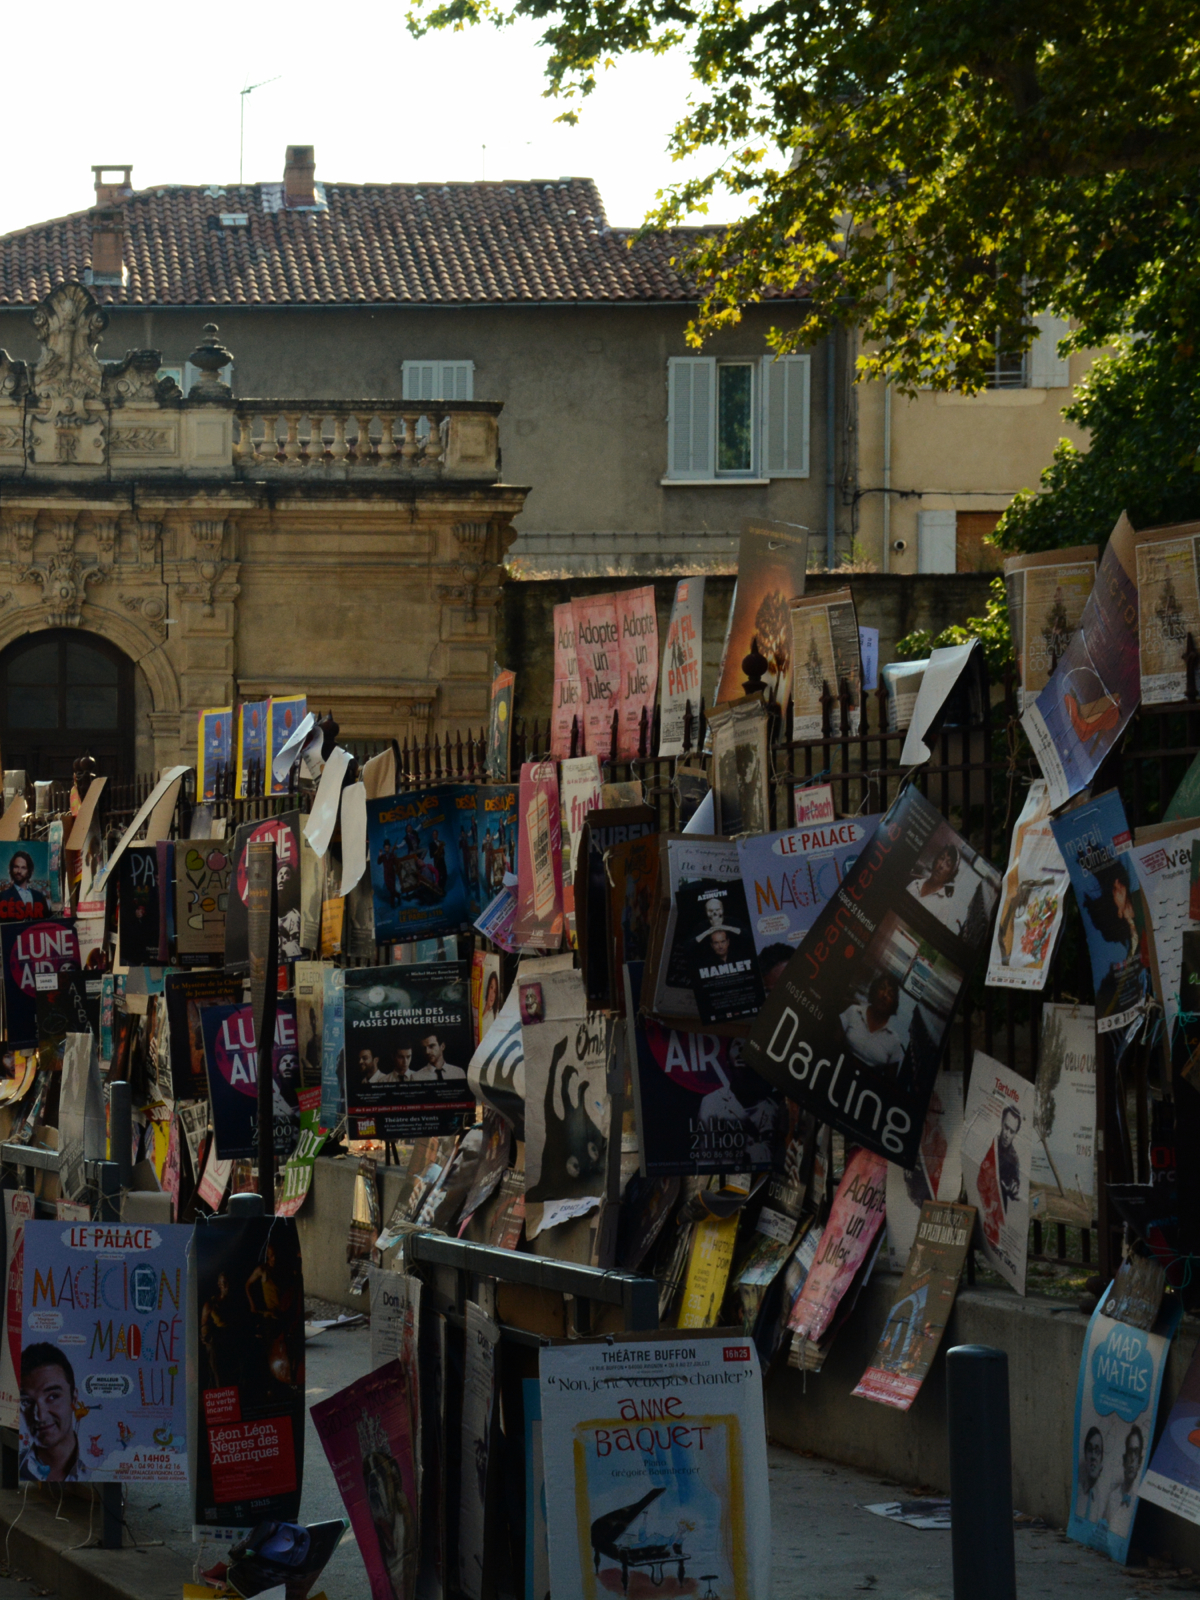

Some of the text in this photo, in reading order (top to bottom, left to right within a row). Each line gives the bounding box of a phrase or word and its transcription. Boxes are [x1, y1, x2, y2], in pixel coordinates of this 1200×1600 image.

[578, 619, 618, 649] Adopte
[623, 610, 654, 639] Adopte
[681, 614, 696, 643] FIL
[592, 651, 609, 671] un
[636, 644, 648, 665] un
[625, 671, 648, 699] Jules
[668, 659, 699, 696] PATTE
[586, 675, 613, 704] Jules
[378, 795, 440, 824] DÉSAXÉS
[780, 825, 857, 855] LE PALACE
[1065, 825, 1103, 857] magali
[697, 889, 728, 902] AZIMUTH
[837, 888, 877, 933] Espace St Martial
[16, 929, 74, 961] LUNE
[699, 959, 752, 979] HAMLET
[181, 981, 206, 991] Mystère
[185, 987, 234, 998] de Jeanne d'Arc
[785, 980, 824, 1022] nosferatu
[352, 1014, 462, 1029] PASSES DANGEREUSES
[369, 1006, 444, 1019] LE CHEMIN DES
[664, 1029, 731, 1089] AIR
[765, 1006, 912, 1154] Darling
[995, 1077, 1020, 1103] Tartuffe
[688, 1117, 744, 1133] LA LUNA
[690, 1151, 700, 1159] 04
[702, 1151, 711, 1159] 90
[713, 1150, 722, 1158] 86
[846, 1214, 865, 1239] un
[71, 1228, 152, 1248] LE PALACE
[32, 1261, 181, 1311] MAGICIEN
[88, 1314, 182, 1361] MALGRÉ
[1107, 1331, 1142, 1362] MAD
[602, 1348, 696, 1363] THÉÂTRE BUFFON
[725, 1349, 748, 1359] 16h25
[1097, 1354, 1149, 1392] MATHS
[205, 1389, 235, 1400] chapelle
[216, 1397, 237, 1406] verbe
[206, 1405, 233, 1415] incarné
[210, 1423, 277, 1442] Léon Léon,
[211, 1434, 279, 1454] Nègres des
[133, 1453, 170, 1463] À 14H05
[212, 1446, 280, 1465] Amériques
[643, 1459, 667, 1467] Piano
